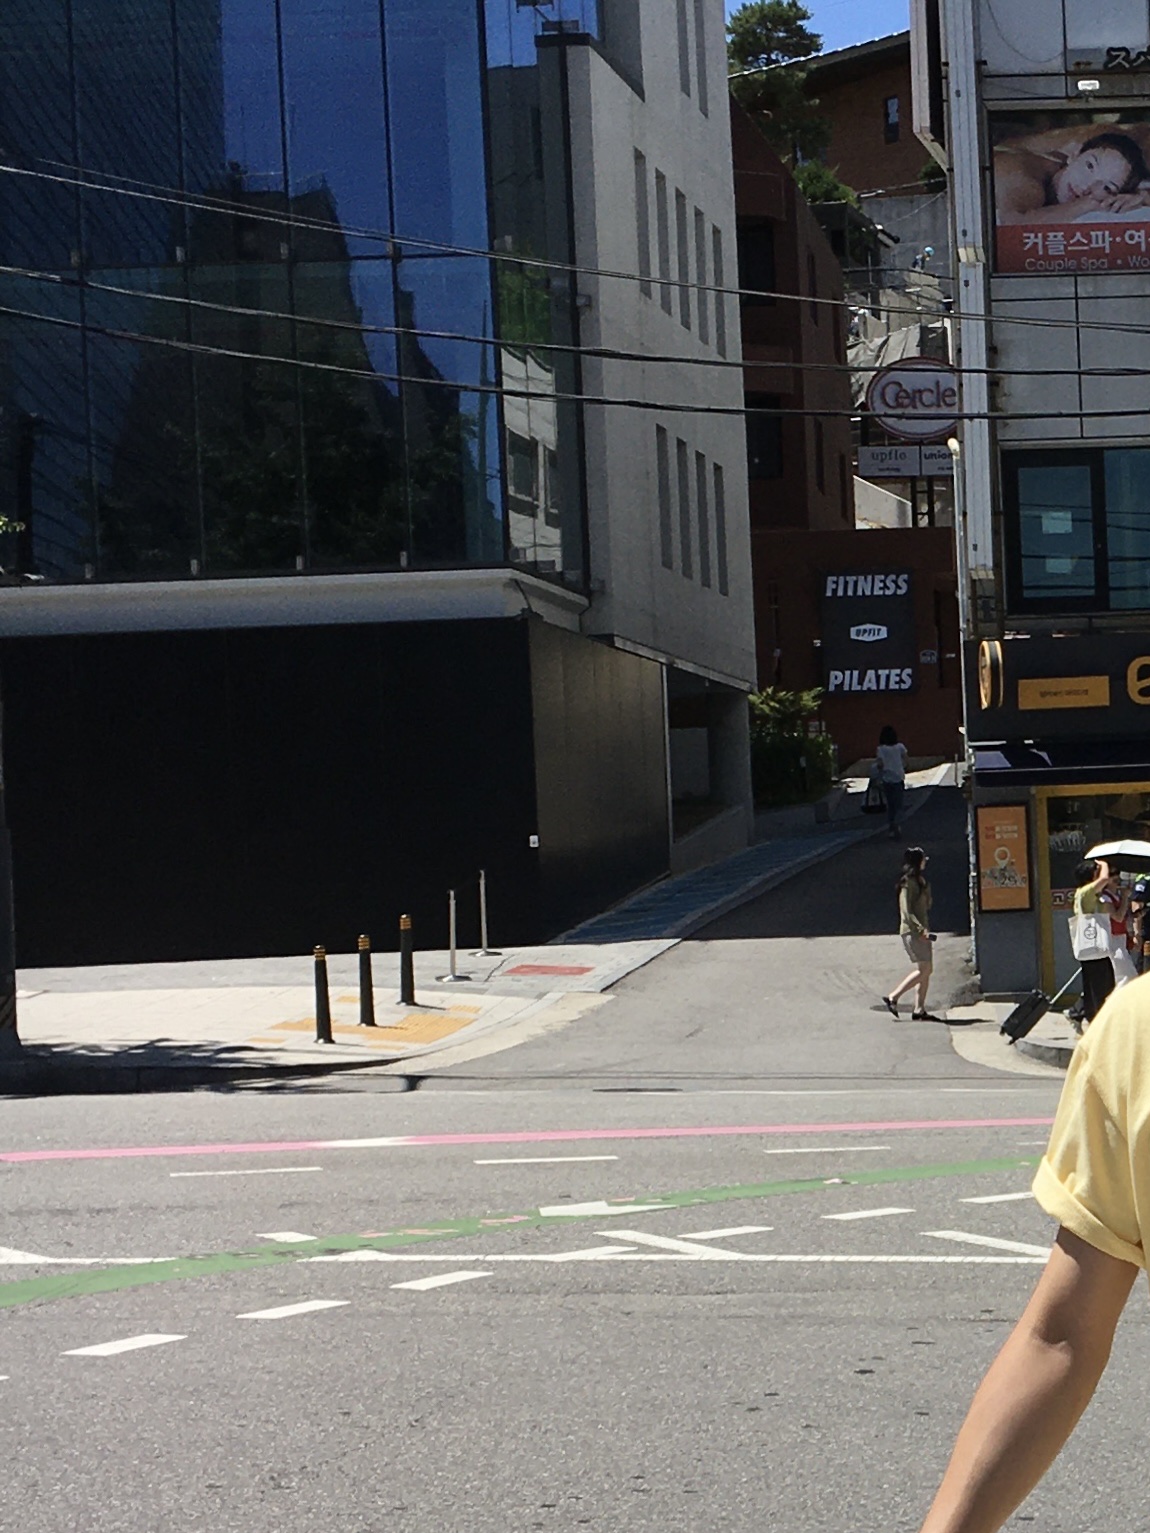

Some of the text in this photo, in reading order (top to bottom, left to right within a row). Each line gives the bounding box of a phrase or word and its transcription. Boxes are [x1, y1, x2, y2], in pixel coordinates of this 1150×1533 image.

[1024, 257, 1077, 272] Couple
[1080, 255, 1109, 271] Spa
[881, 379, 958, 410] Cercle
[825, 574, 909, 597] FITNESS
[855, 627, 882, 638] UPFIT
[828, 667, 913, 692] PILATES
